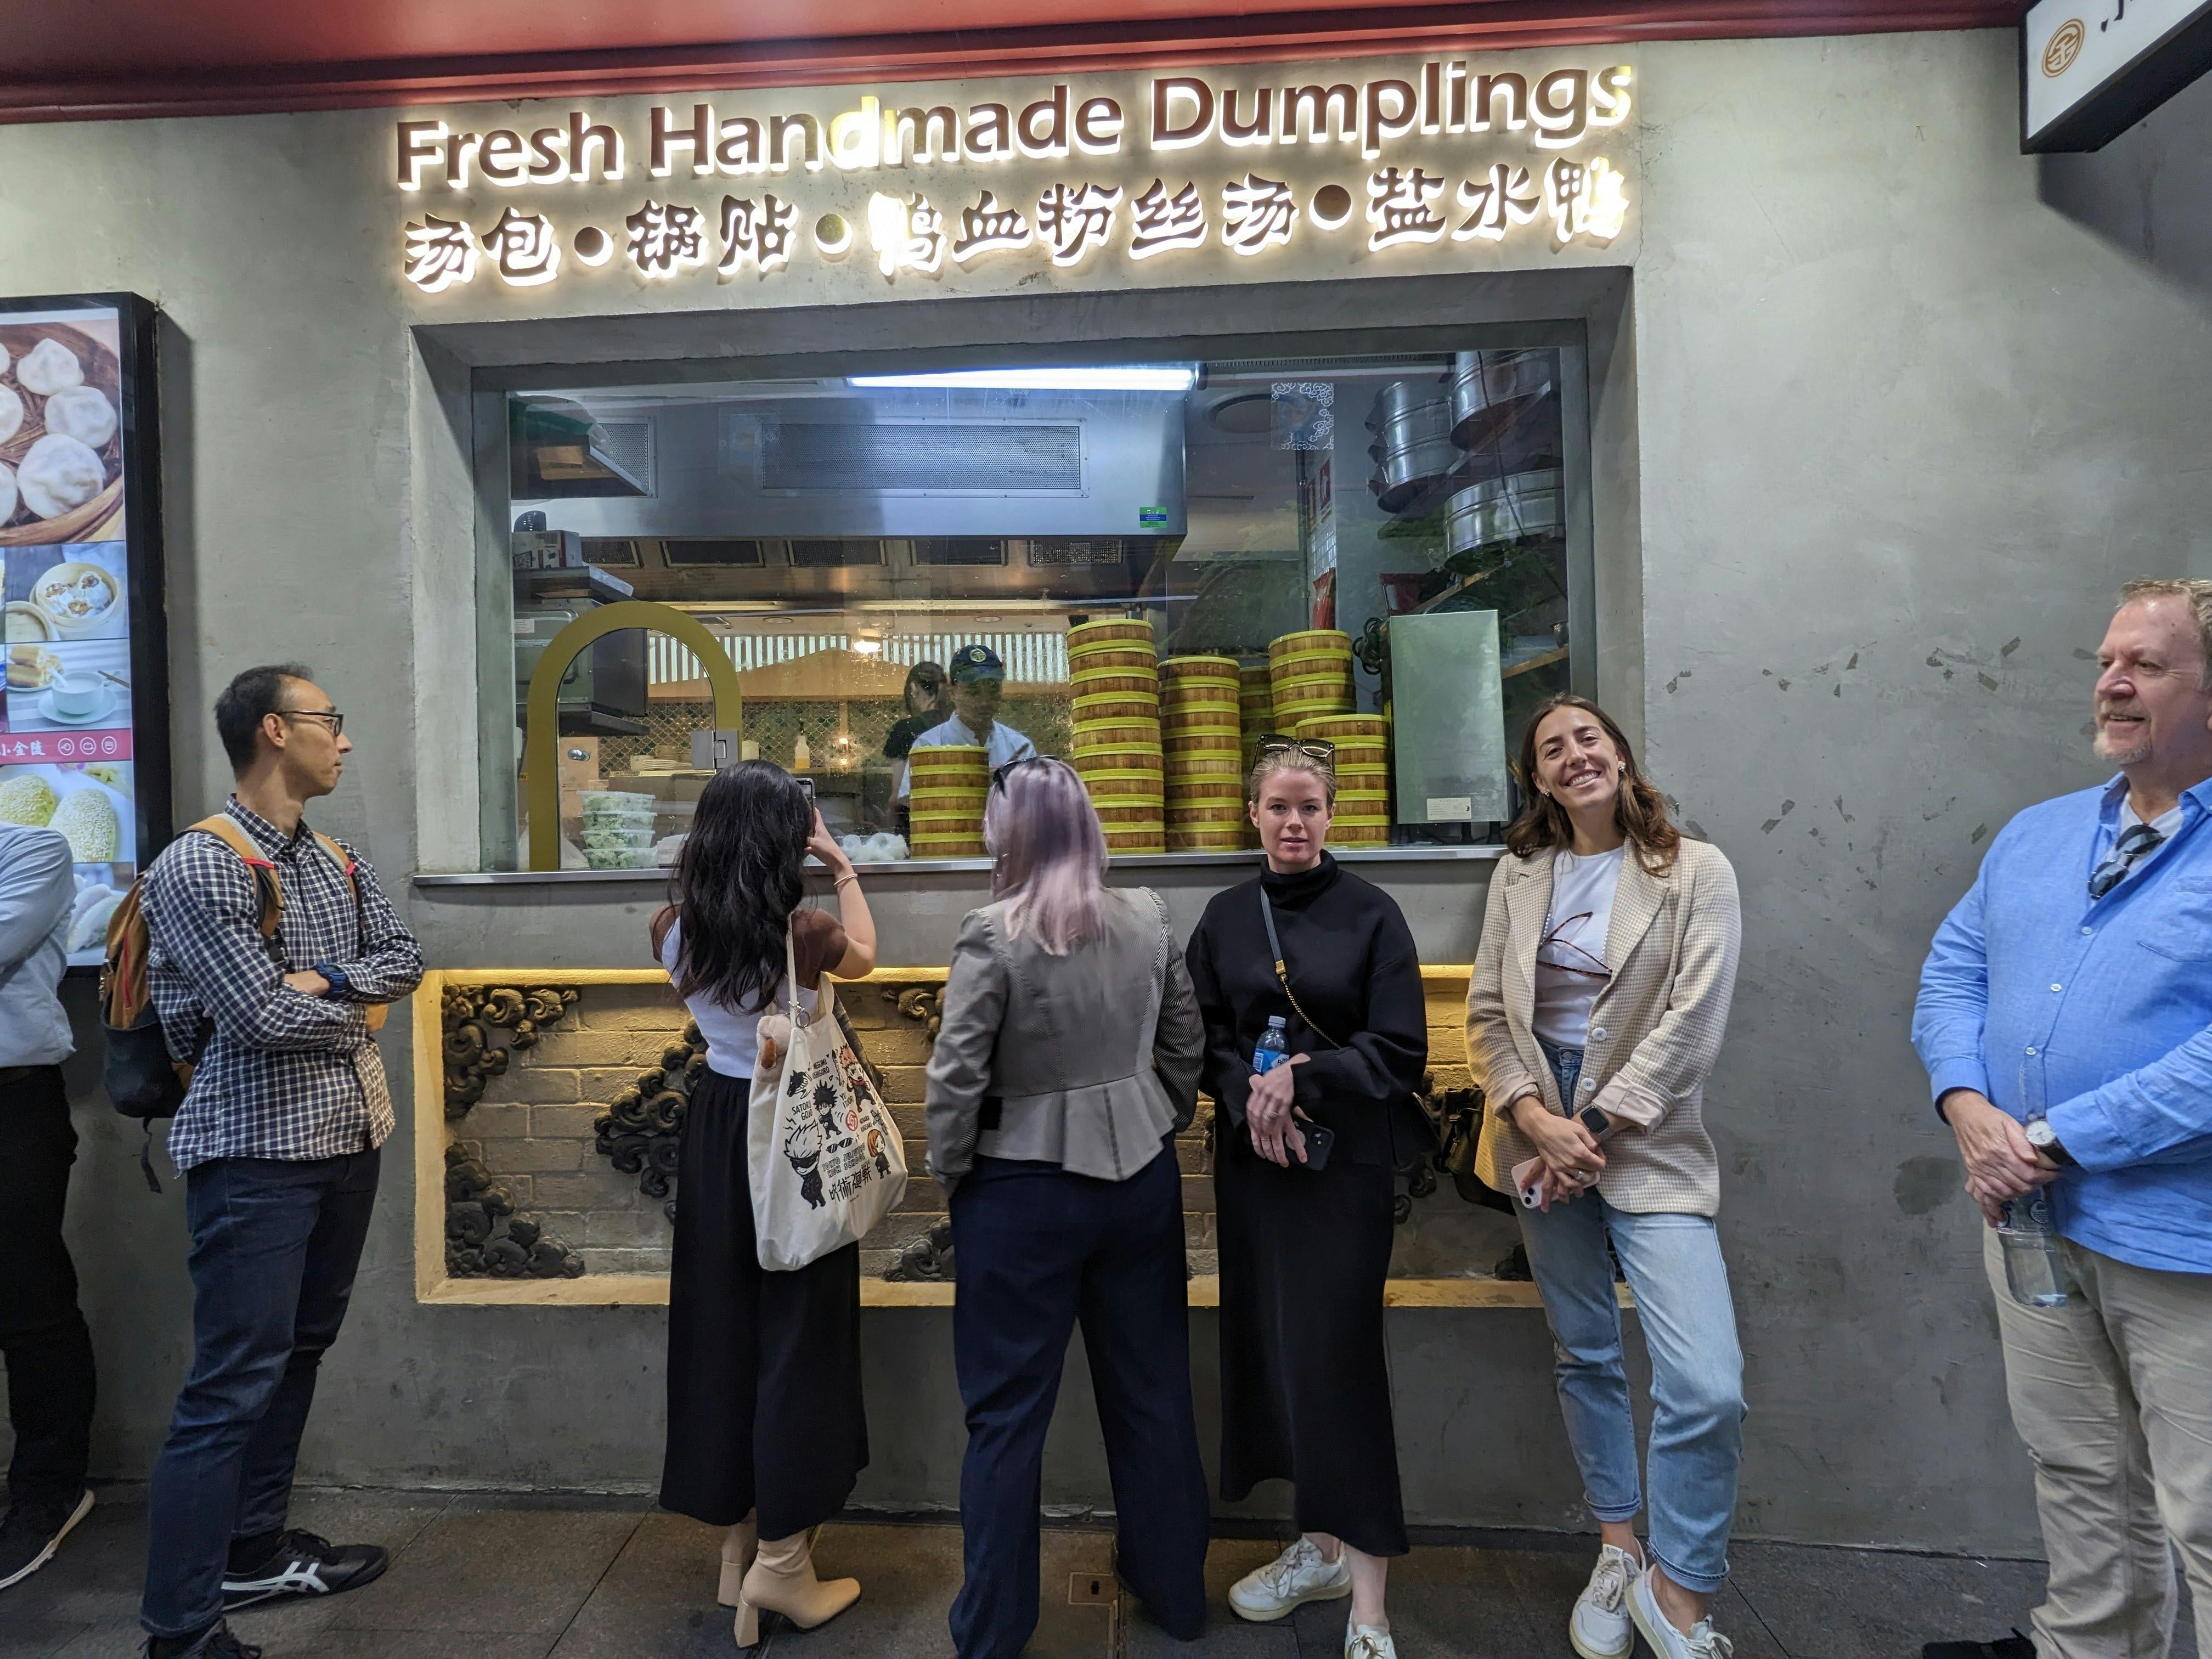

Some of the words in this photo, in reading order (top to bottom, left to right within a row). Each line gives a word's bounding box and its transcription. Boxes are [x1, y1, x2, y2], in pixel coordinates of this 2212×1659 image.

[397, 111, 624, 191] Fresh
[651, 84, 1124, 179] Handmade
[1151, 60, 1632, 159] Dumplings
[404, 206, 561, 293] 汤包
[626, 194, 798, 279] 锅贴
[1366, 156, 1630, 252] 盐水鸭
